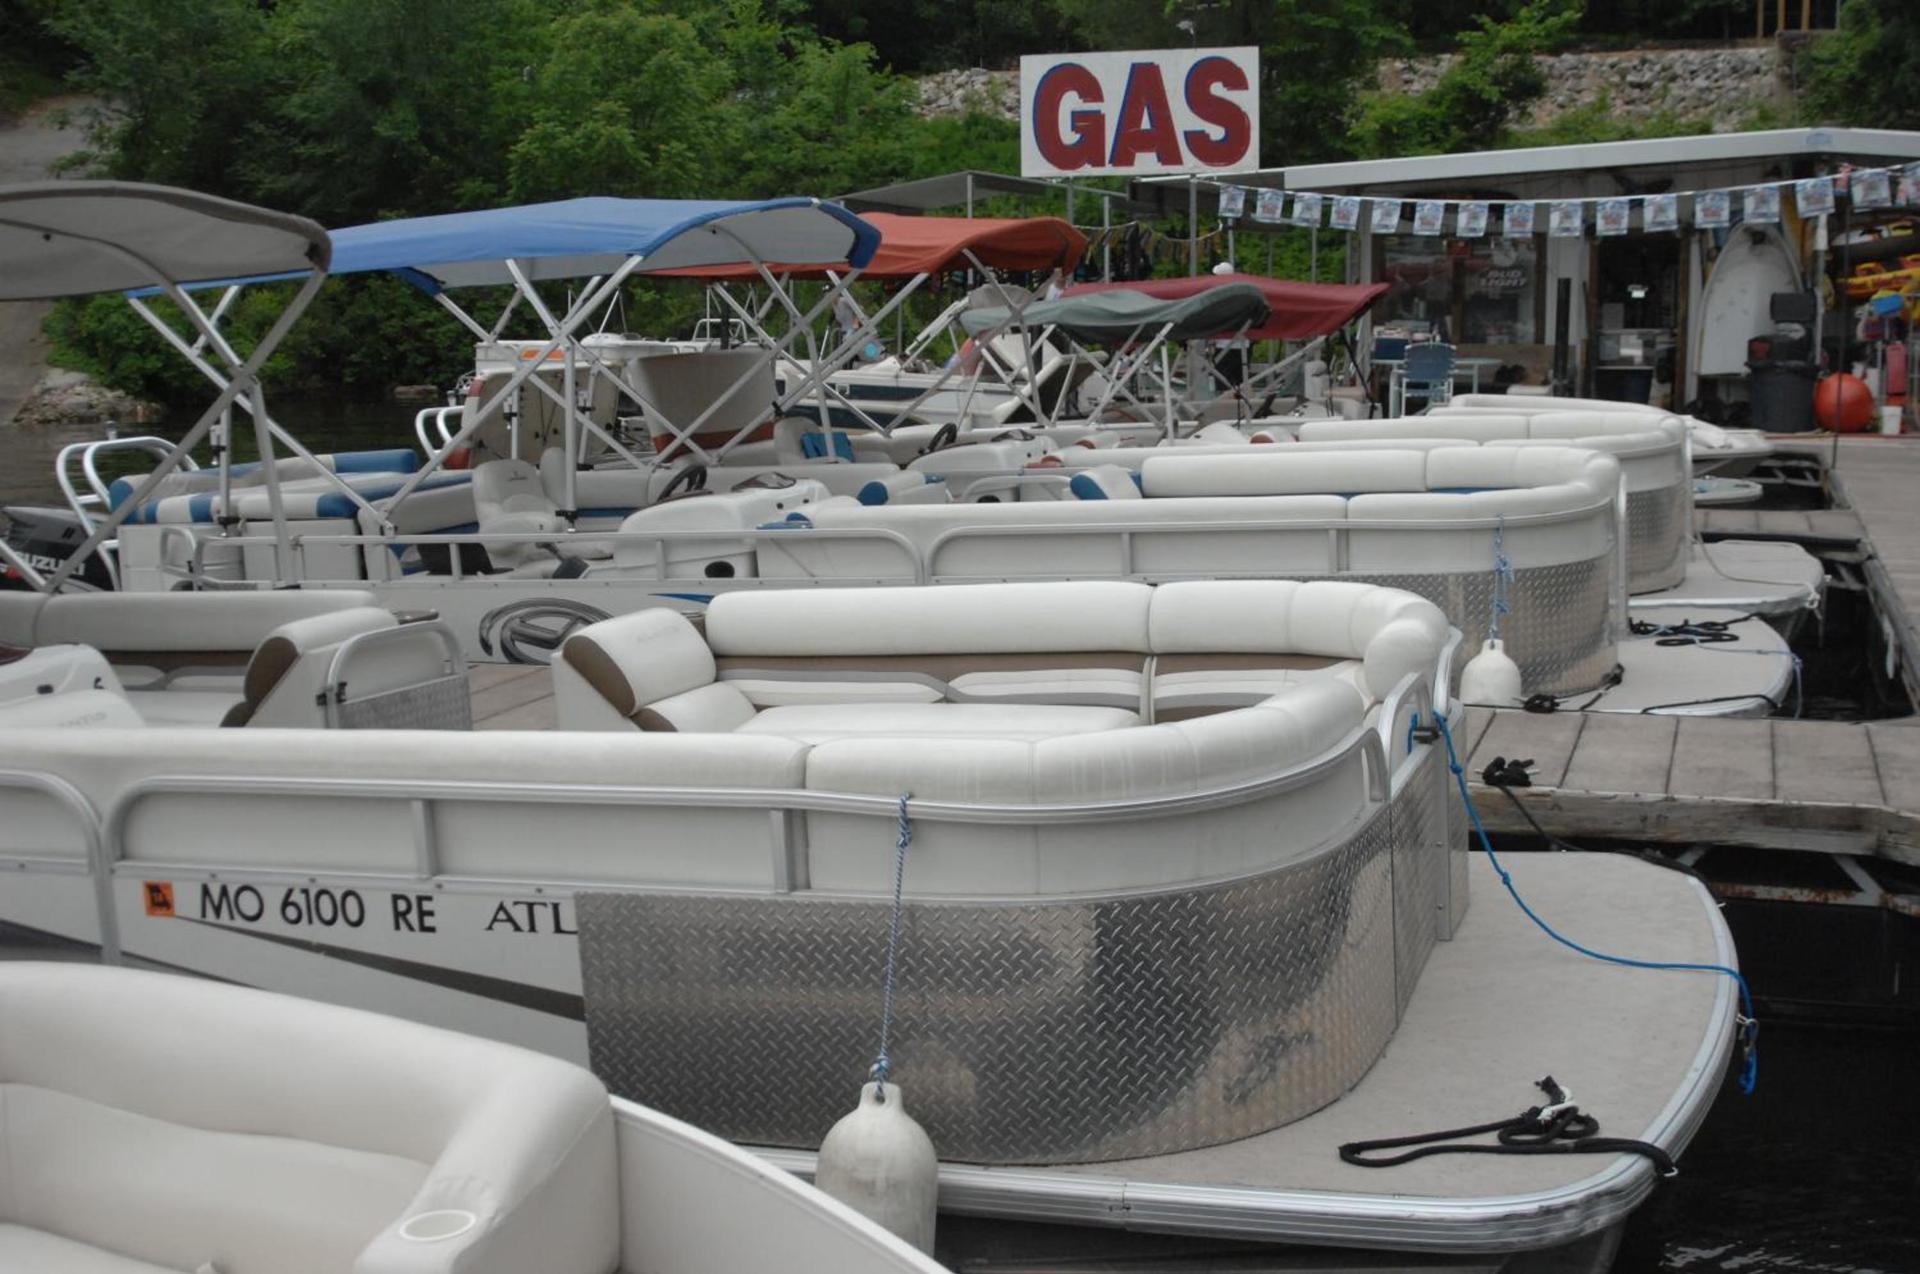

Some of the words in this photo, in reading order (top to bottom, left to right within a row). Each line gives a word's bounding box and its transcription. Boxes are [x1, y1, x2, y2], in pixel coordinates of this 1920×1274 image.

[1033, 56, 1251, 171] GAS
[200, 883, 264, 923] MO
[281, 888, 366, 928] 6100
[391, 894, 436, 933] RE
[484, 900, 578, 935] ATL
